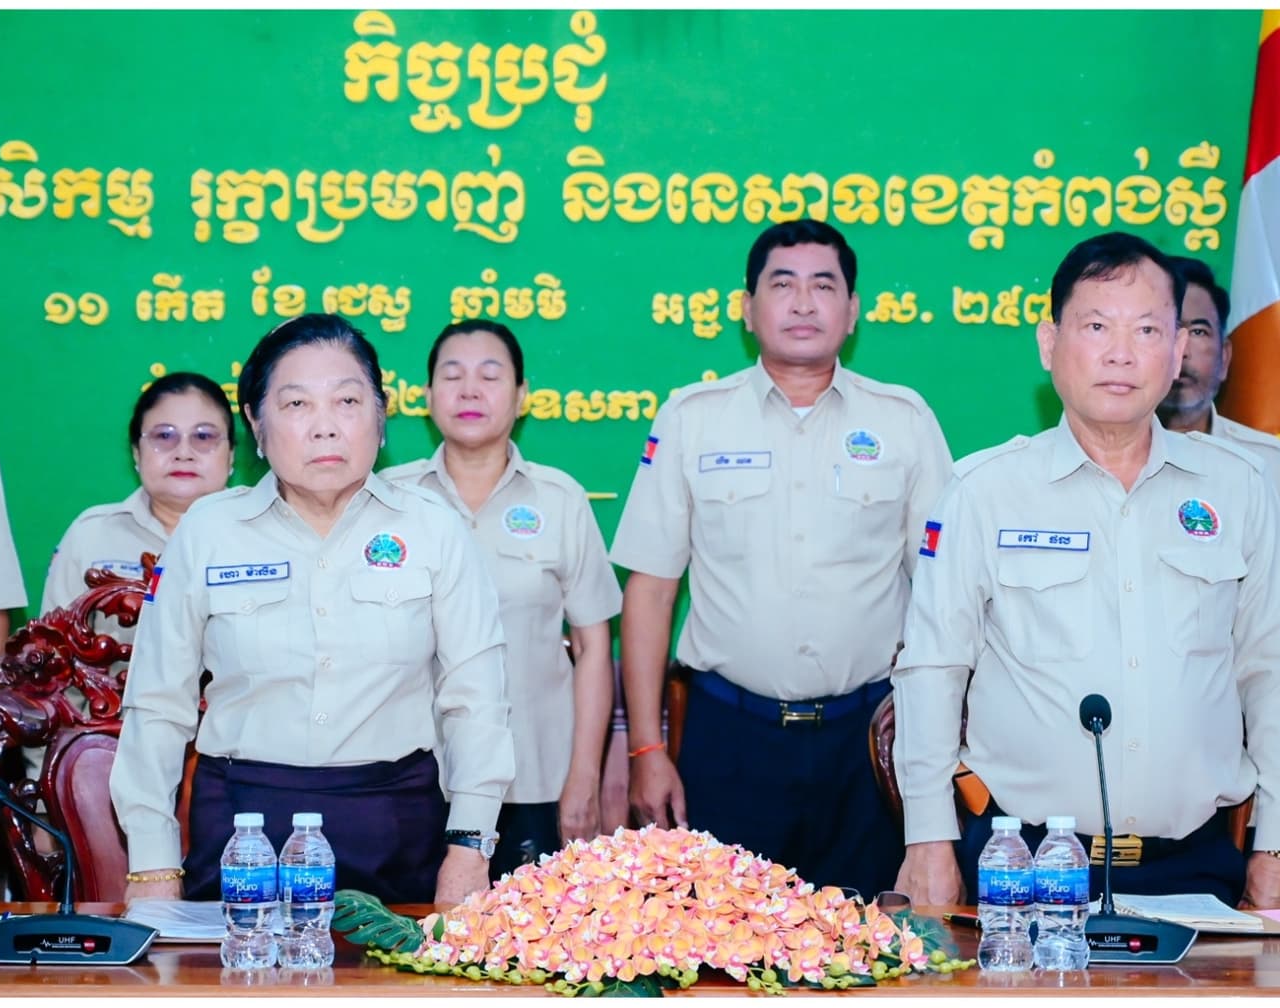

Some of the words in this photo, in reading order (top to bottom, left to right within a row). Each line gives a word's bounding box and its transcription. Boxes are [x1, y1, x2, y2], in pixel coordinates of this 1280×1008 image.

[345, 9, 607, 132] កិច្ចប្រជុំ
[191, 143, 526, 243] រុក្ខាប្រមាញ់
[45, 292, 109, 326] ១១
[136, 272, 226, 322] កើត
[252, 265, 307, 317] ខែ
[450, 268, 567, 325] ឆ្ាំមមី
[953, 285, 1053, 326] ២៥៧
